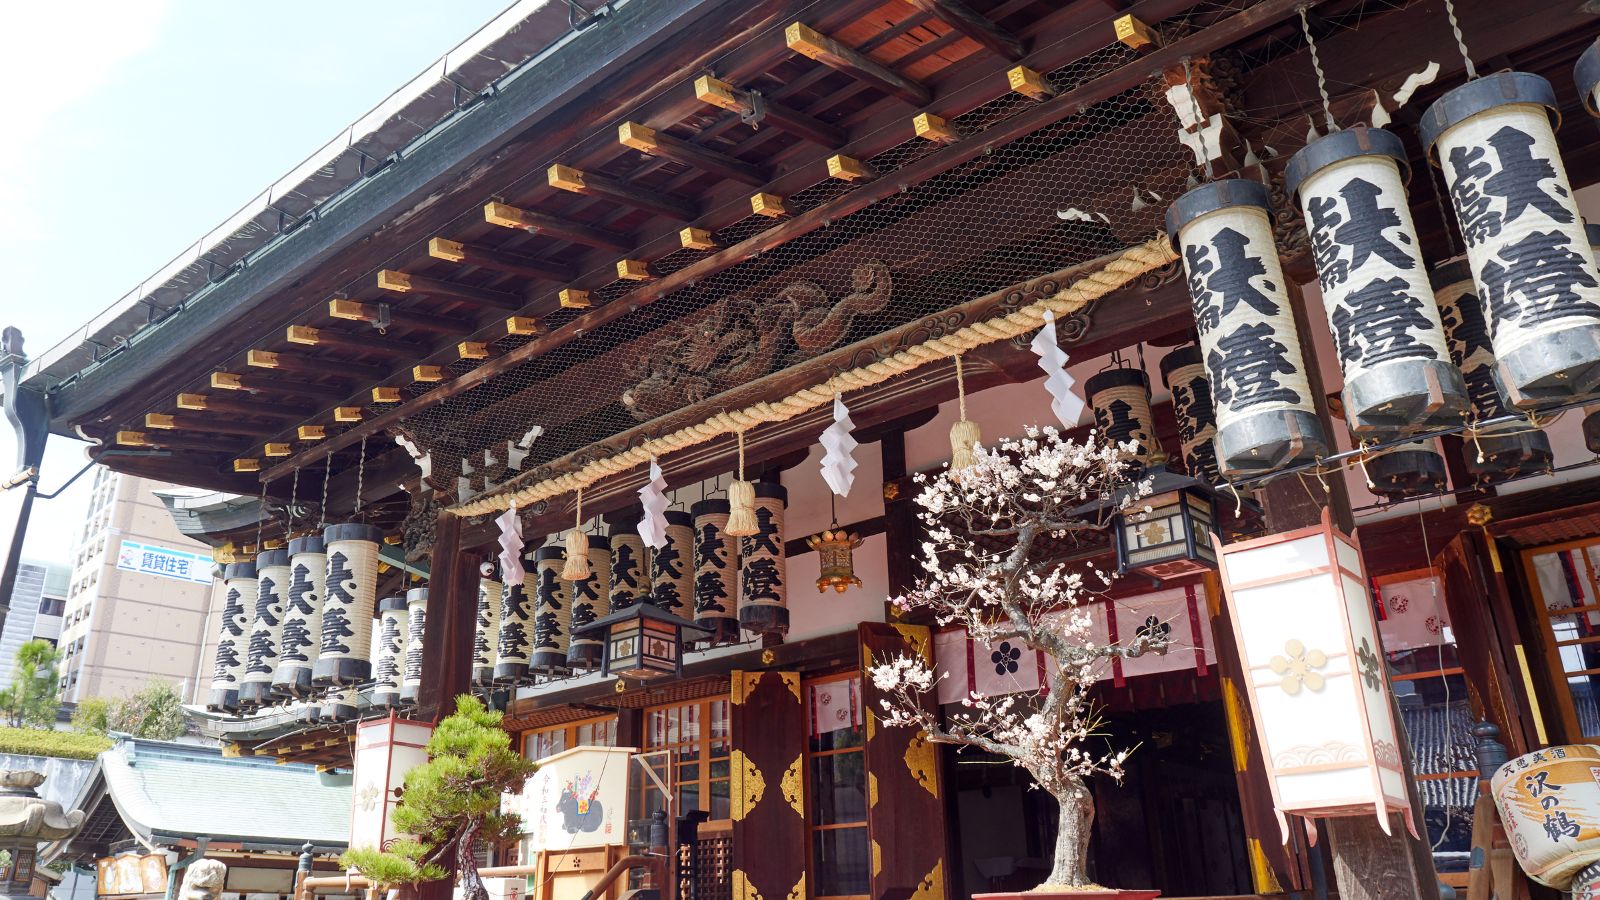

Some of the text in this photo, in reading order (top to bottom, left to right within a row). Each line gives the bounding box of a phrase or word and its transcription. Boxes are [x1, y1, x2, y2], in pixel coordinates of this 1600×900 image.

[141, 552, 189, 575] 賃貸住宅
[1524, 771, 1581, 843] 沢の鶴
